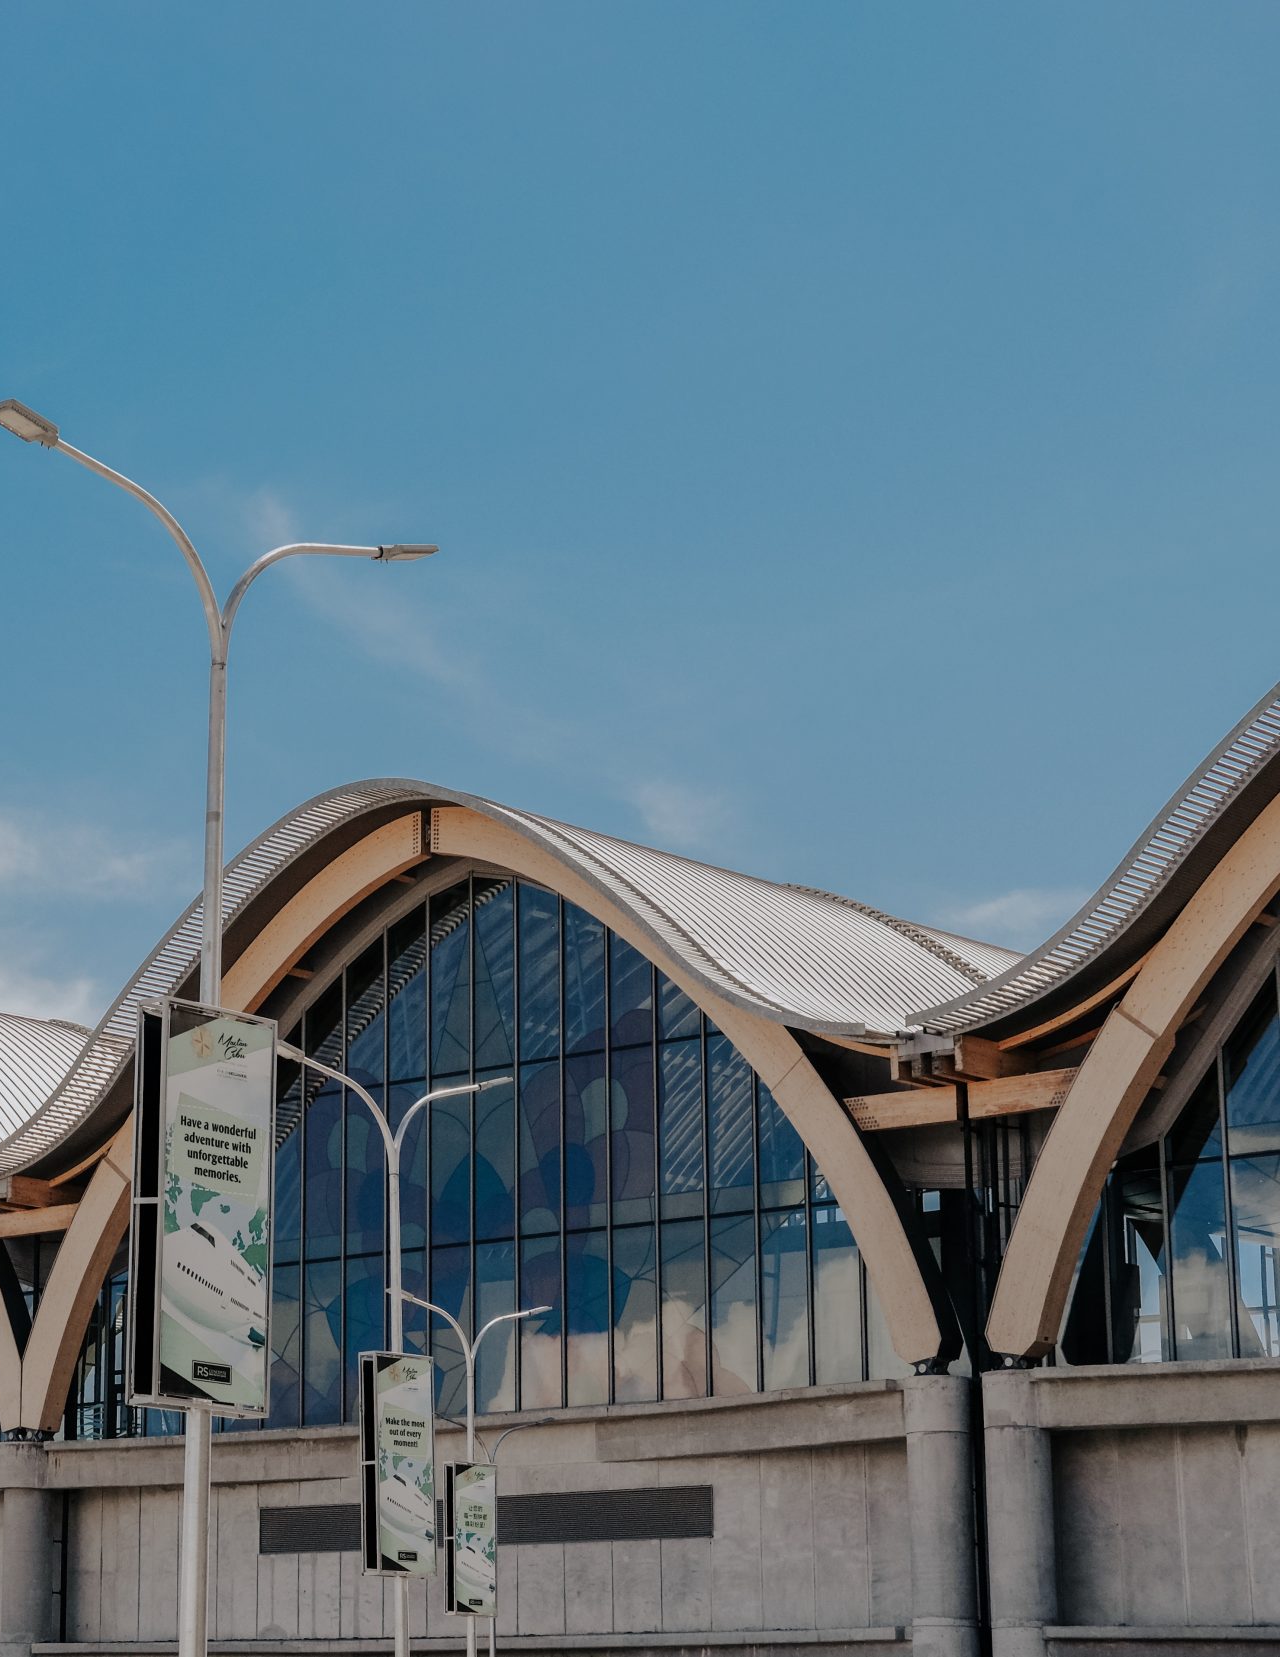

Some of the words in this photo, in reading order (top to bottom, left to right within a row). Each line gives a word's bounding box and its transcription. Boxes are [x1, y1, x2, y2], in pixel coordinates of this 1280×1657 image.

[180, 1115, 202, 1129] Have
[204, 1121, 209, 1130] a
[211, 1123, 257, 1140] wonderful
[184, 1132, 230, 1150] adventure
[232, 1141, 252, 1154] with
[187, 1149, 249, 1169] unforgettable
[194, 1166, 242, 1184] memories.
[197, 1366, 209, 1377] RS
[385, 1417, 400, 1426] Make
[401, 1418, 410, 1426] the
[411, 1420, 425, 1428] most
[406, 1431, 422, 1440] every
[393, 1440, 418, 1448] moment!
